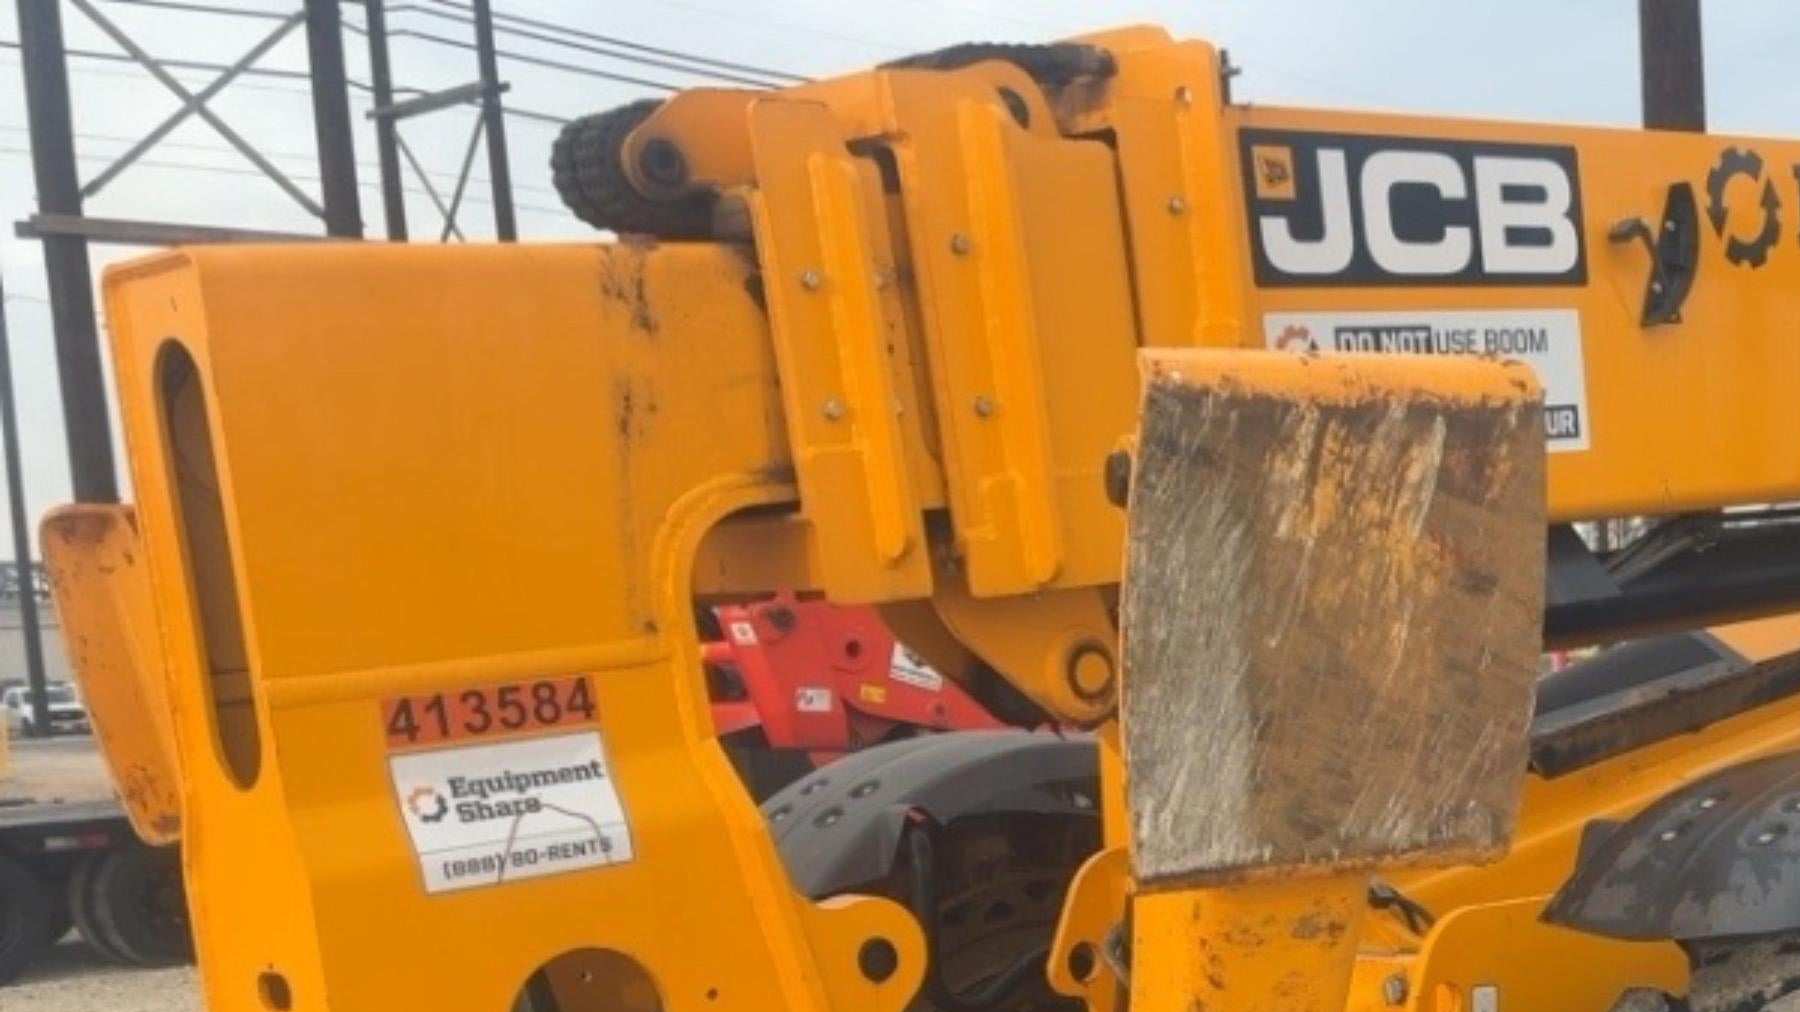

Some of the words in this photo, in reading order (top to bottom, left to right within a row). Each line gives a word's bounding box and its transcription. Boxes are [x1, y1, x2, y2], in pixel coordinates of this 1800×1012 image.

[1259, 147, 1579, 274] JCB
[1339, 330, 1374, 352] DO
[1380, 330, 1429, 353] NOT
[1436, 330, 1477, 354] USE
[1484, 329, 1548, 354] BOOM
[386, 677, 596, 742] 413584
[447, 759, 604, 800] Equipment
[455, 796, 543, 823] Share
